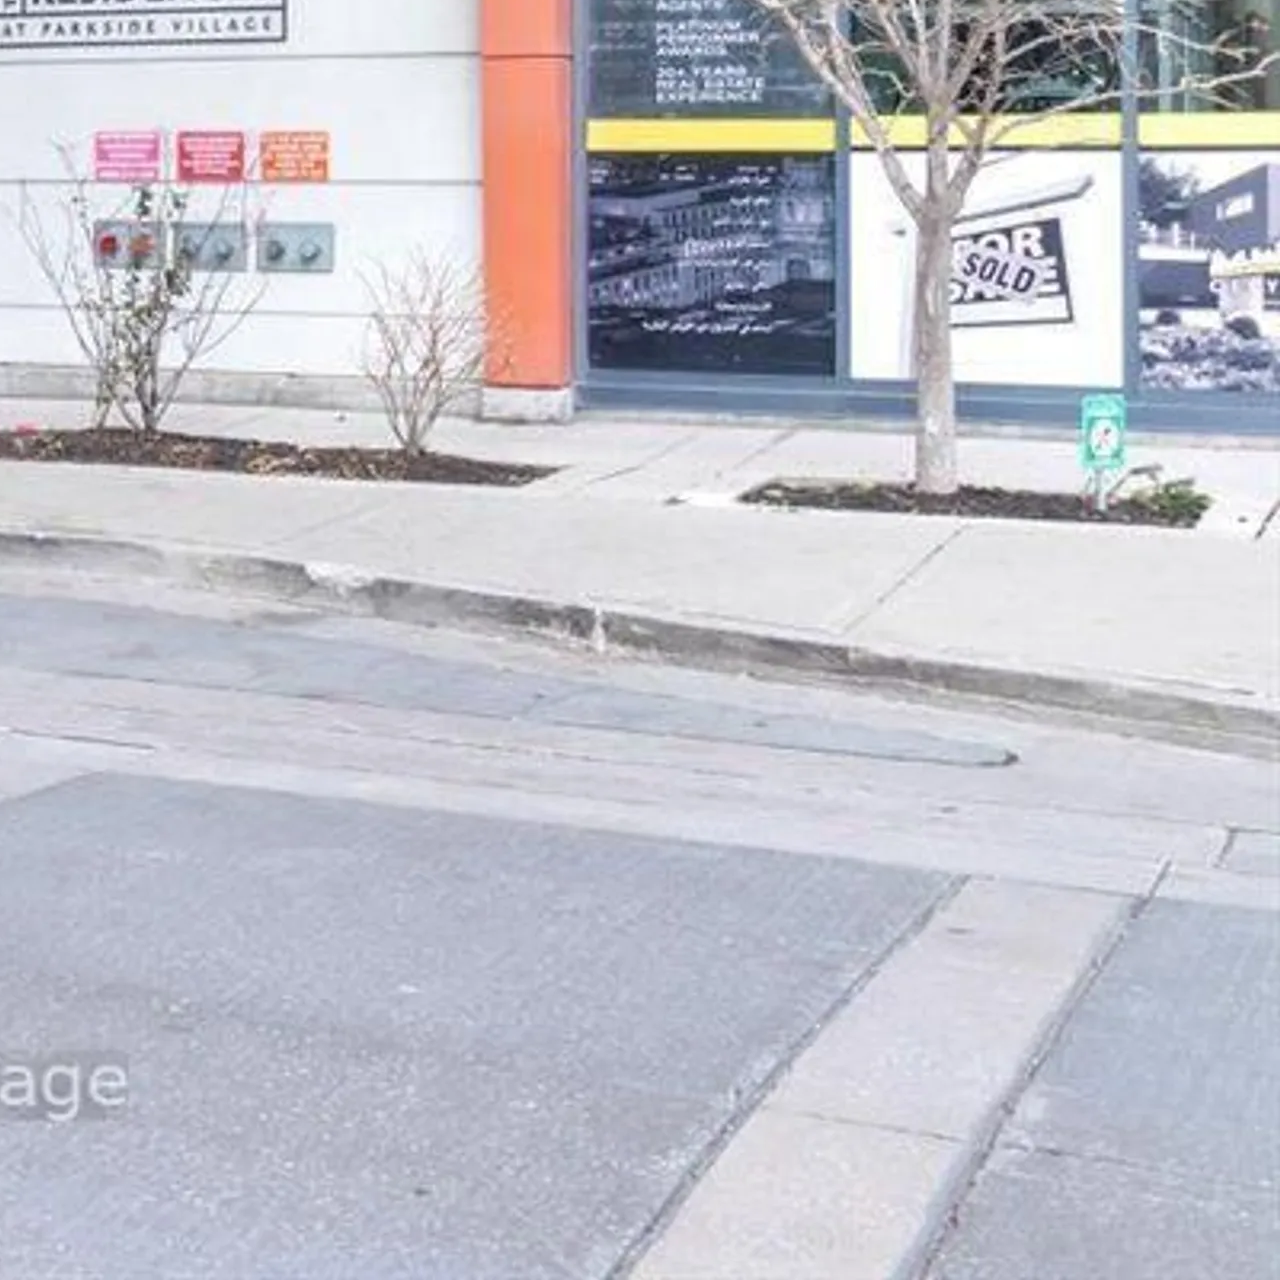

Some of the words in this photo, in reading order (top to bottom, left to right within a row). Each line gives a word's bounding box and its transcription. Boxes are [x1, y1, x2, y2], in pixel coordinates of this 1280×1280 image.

[2, 22, 26, 37] AT
[39, 19, 156, 37] PARKSIDE
[172, 16, 272, 34] VILLAGE
[961, 252, 1037, 294] SOLD
